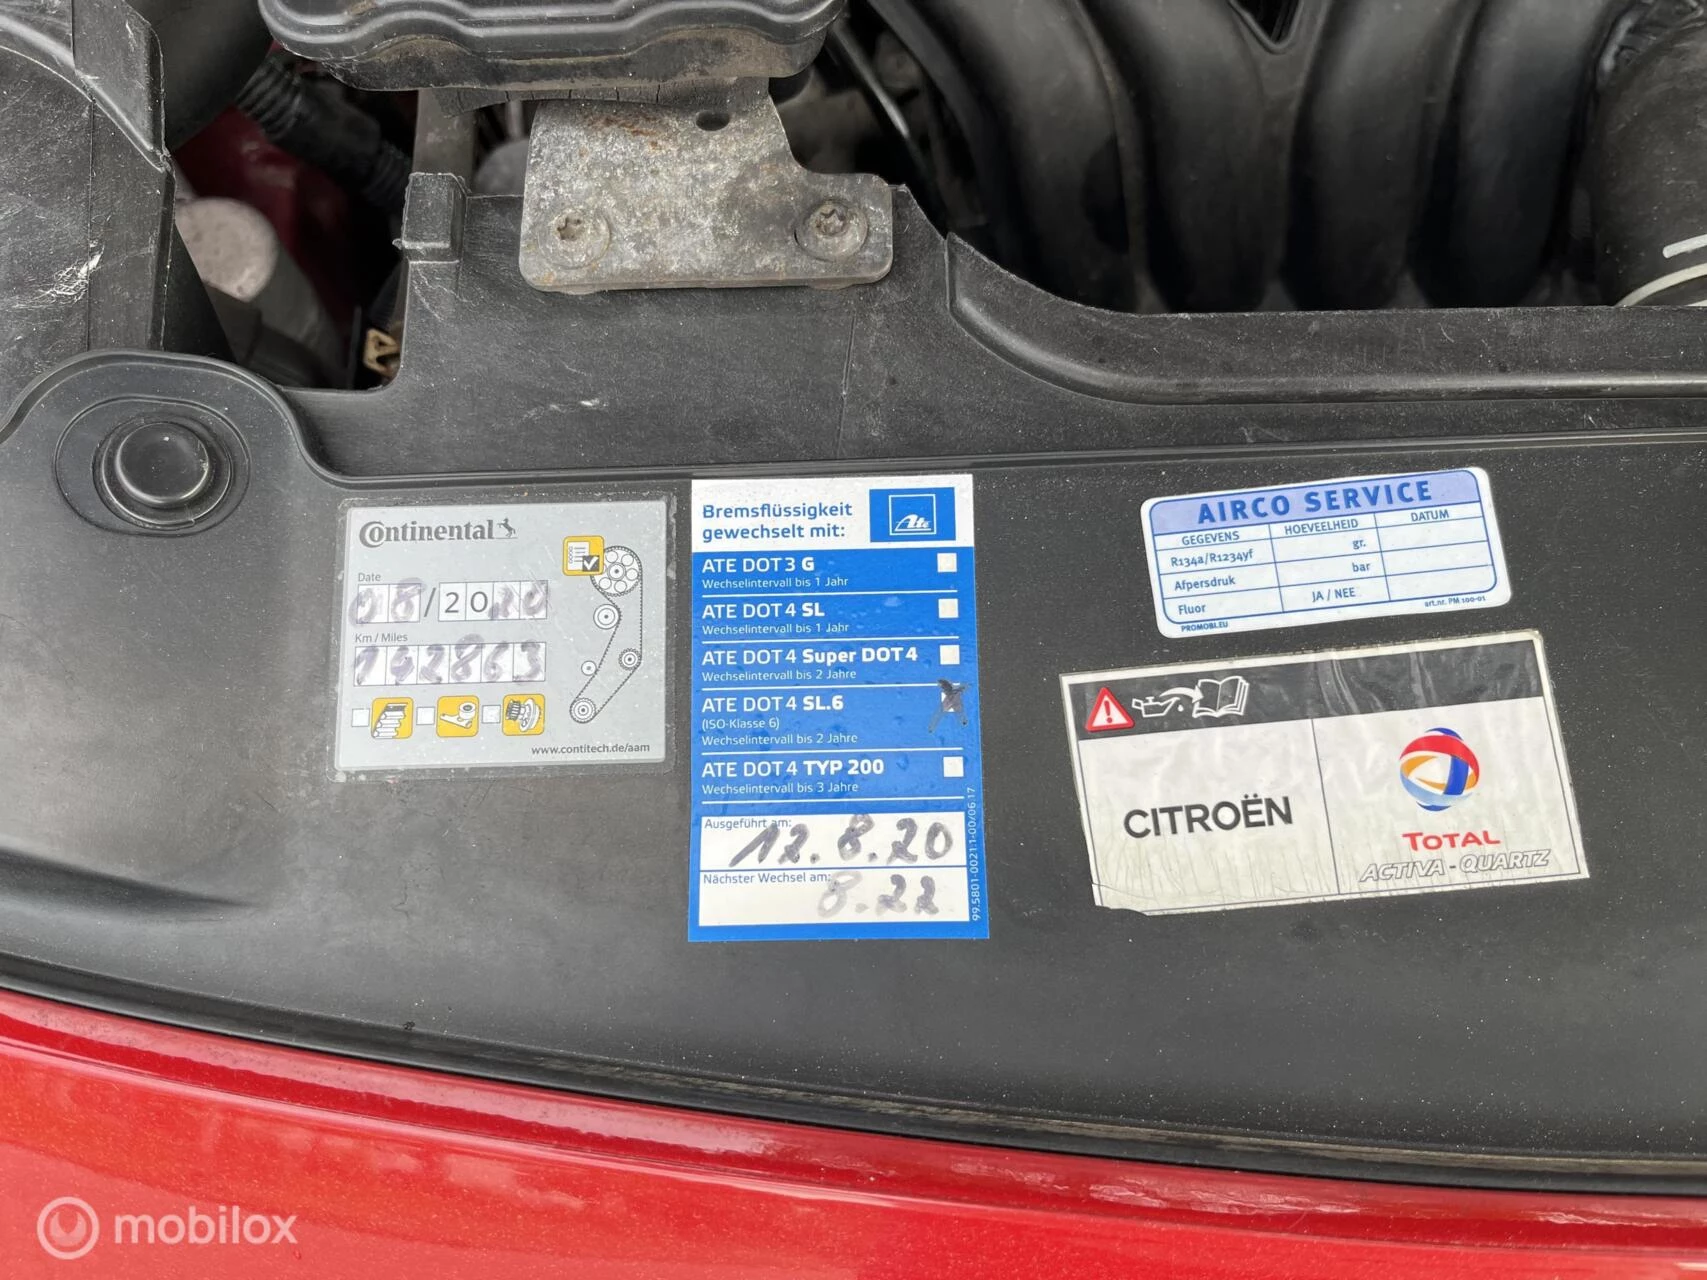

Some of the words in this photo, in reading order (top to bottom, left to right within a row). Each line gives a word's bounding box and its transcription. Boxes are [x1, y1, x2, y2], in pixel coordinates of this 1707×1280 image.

[1198, 495, 1290, 524] AIRCO
[1305, 480, 1432, 513] SERVICE
[702, 502, 853, 520] Bremsflüssigkeit
[1410, 509, 1450, 522] DATUM
[359, 519, 494, 548] Continental
[702, 524, 805, 543] gewechselt
[810, 523, 846, 538] mit:
[1284, 518, 1359, 535] HOEVEELHEID
[1181, 530, 1240, 546] GEGEVENS
[1352, 538, 1366, 550] gr.
[702, 558, 737, 573] ATE
[743, 557, 782, 572] DOT
[785, 557, 796, 571] 3
[801, 556, 815, 571] G
[1171, 549, 1254, 567] R134a/R1234yf
[1352, 561, 1370, 573] bar
[358, 572, 382, 583] Date
[702, 577, 792, 589] Wechselintervall
[795, 577, 811, 587] bis
[814, 577, 821, 587] 1
[825, 576, 849, 587] Jahr
[1174, 575, 1236, 592] Afpersdruk
[1312, 589, 1325, 602] JA
[1326, 588, 1333, 602] /
[1334, 587, 1356, 599] NEE
[702, 603, 737, 619] ATE
[743, 603, 782, 618] DOT
[785, 603, 796, 617] 4
[801, 602, 825, 617] SL
[1178, 604, 1206, 615] Fluor
[702, 623, 792, 635] Wechselintervall
[795, 622, 811, 633] bis
[815, 622, 821, 633] 1
[825, 622, 849, 633] Jahr
[355, 632, 372, 643] Km
[374, 633, 380, 643] /
[381, 631, 408, 643] Miles
[702, 650, 737, 666] ATE
[743, 649, 783, 665] DOT
[785, 649, 797, 664] 4
[802, 647, 856, 666] Super
[861, 647, 903, 662] DOT
[905, 646, 918, 661] 4
[702, 669, 793, 682] Wechselintervall
[796, 669, 812, 680] bis
[816, 669, 823, 680] 2
[826, 668, 857, 680] Jahre
[702, 697, 737, 713] ATE
[743, 696, 783, 712] DOT
[785, 696, 797, 711] 4
[802, 695, 844, 711] SL.6
[702, 717, 766, 730] (ISO-Klasse
[768, 717, 780, 729] 6)
[702, 734, 793, 746] Wechselintervall
[796, 733, 812, 744] bis
[816, 733, 823, 744] 2
[827, 732, 858, 744] Jahre
[531, 743, 650, 755] www.contitech.de/aam
[702, 761, 737, 778] ATE
[743, 761, 784, 777] DOT
[786, 761, 798, 776] 4
[803, 760, 843, 776] TYP
[847, 759, 885, 775] 200
[702, 782, 794, 795] Wechselintervall
[797, 782, 813, 793] bis
[817, 782, 824, 793] 3
[827, 781, 859, 793] Jahre
[1123, 793, 1293, 839] CITROËN
[704, 817, 767, 831] Ausgeführt
[768, 818, 792, 828] am:
[1402, 830, 1501, 852] TOTAL
[1360, 854, 1446, 883] ACTIVA
[1459, 849, 1551, 874] QUARTZ
[703, 871, 756, 884] Nächster
[758, 871, 806, 884] Wechsel
[808, 873, 832, 883] am:
